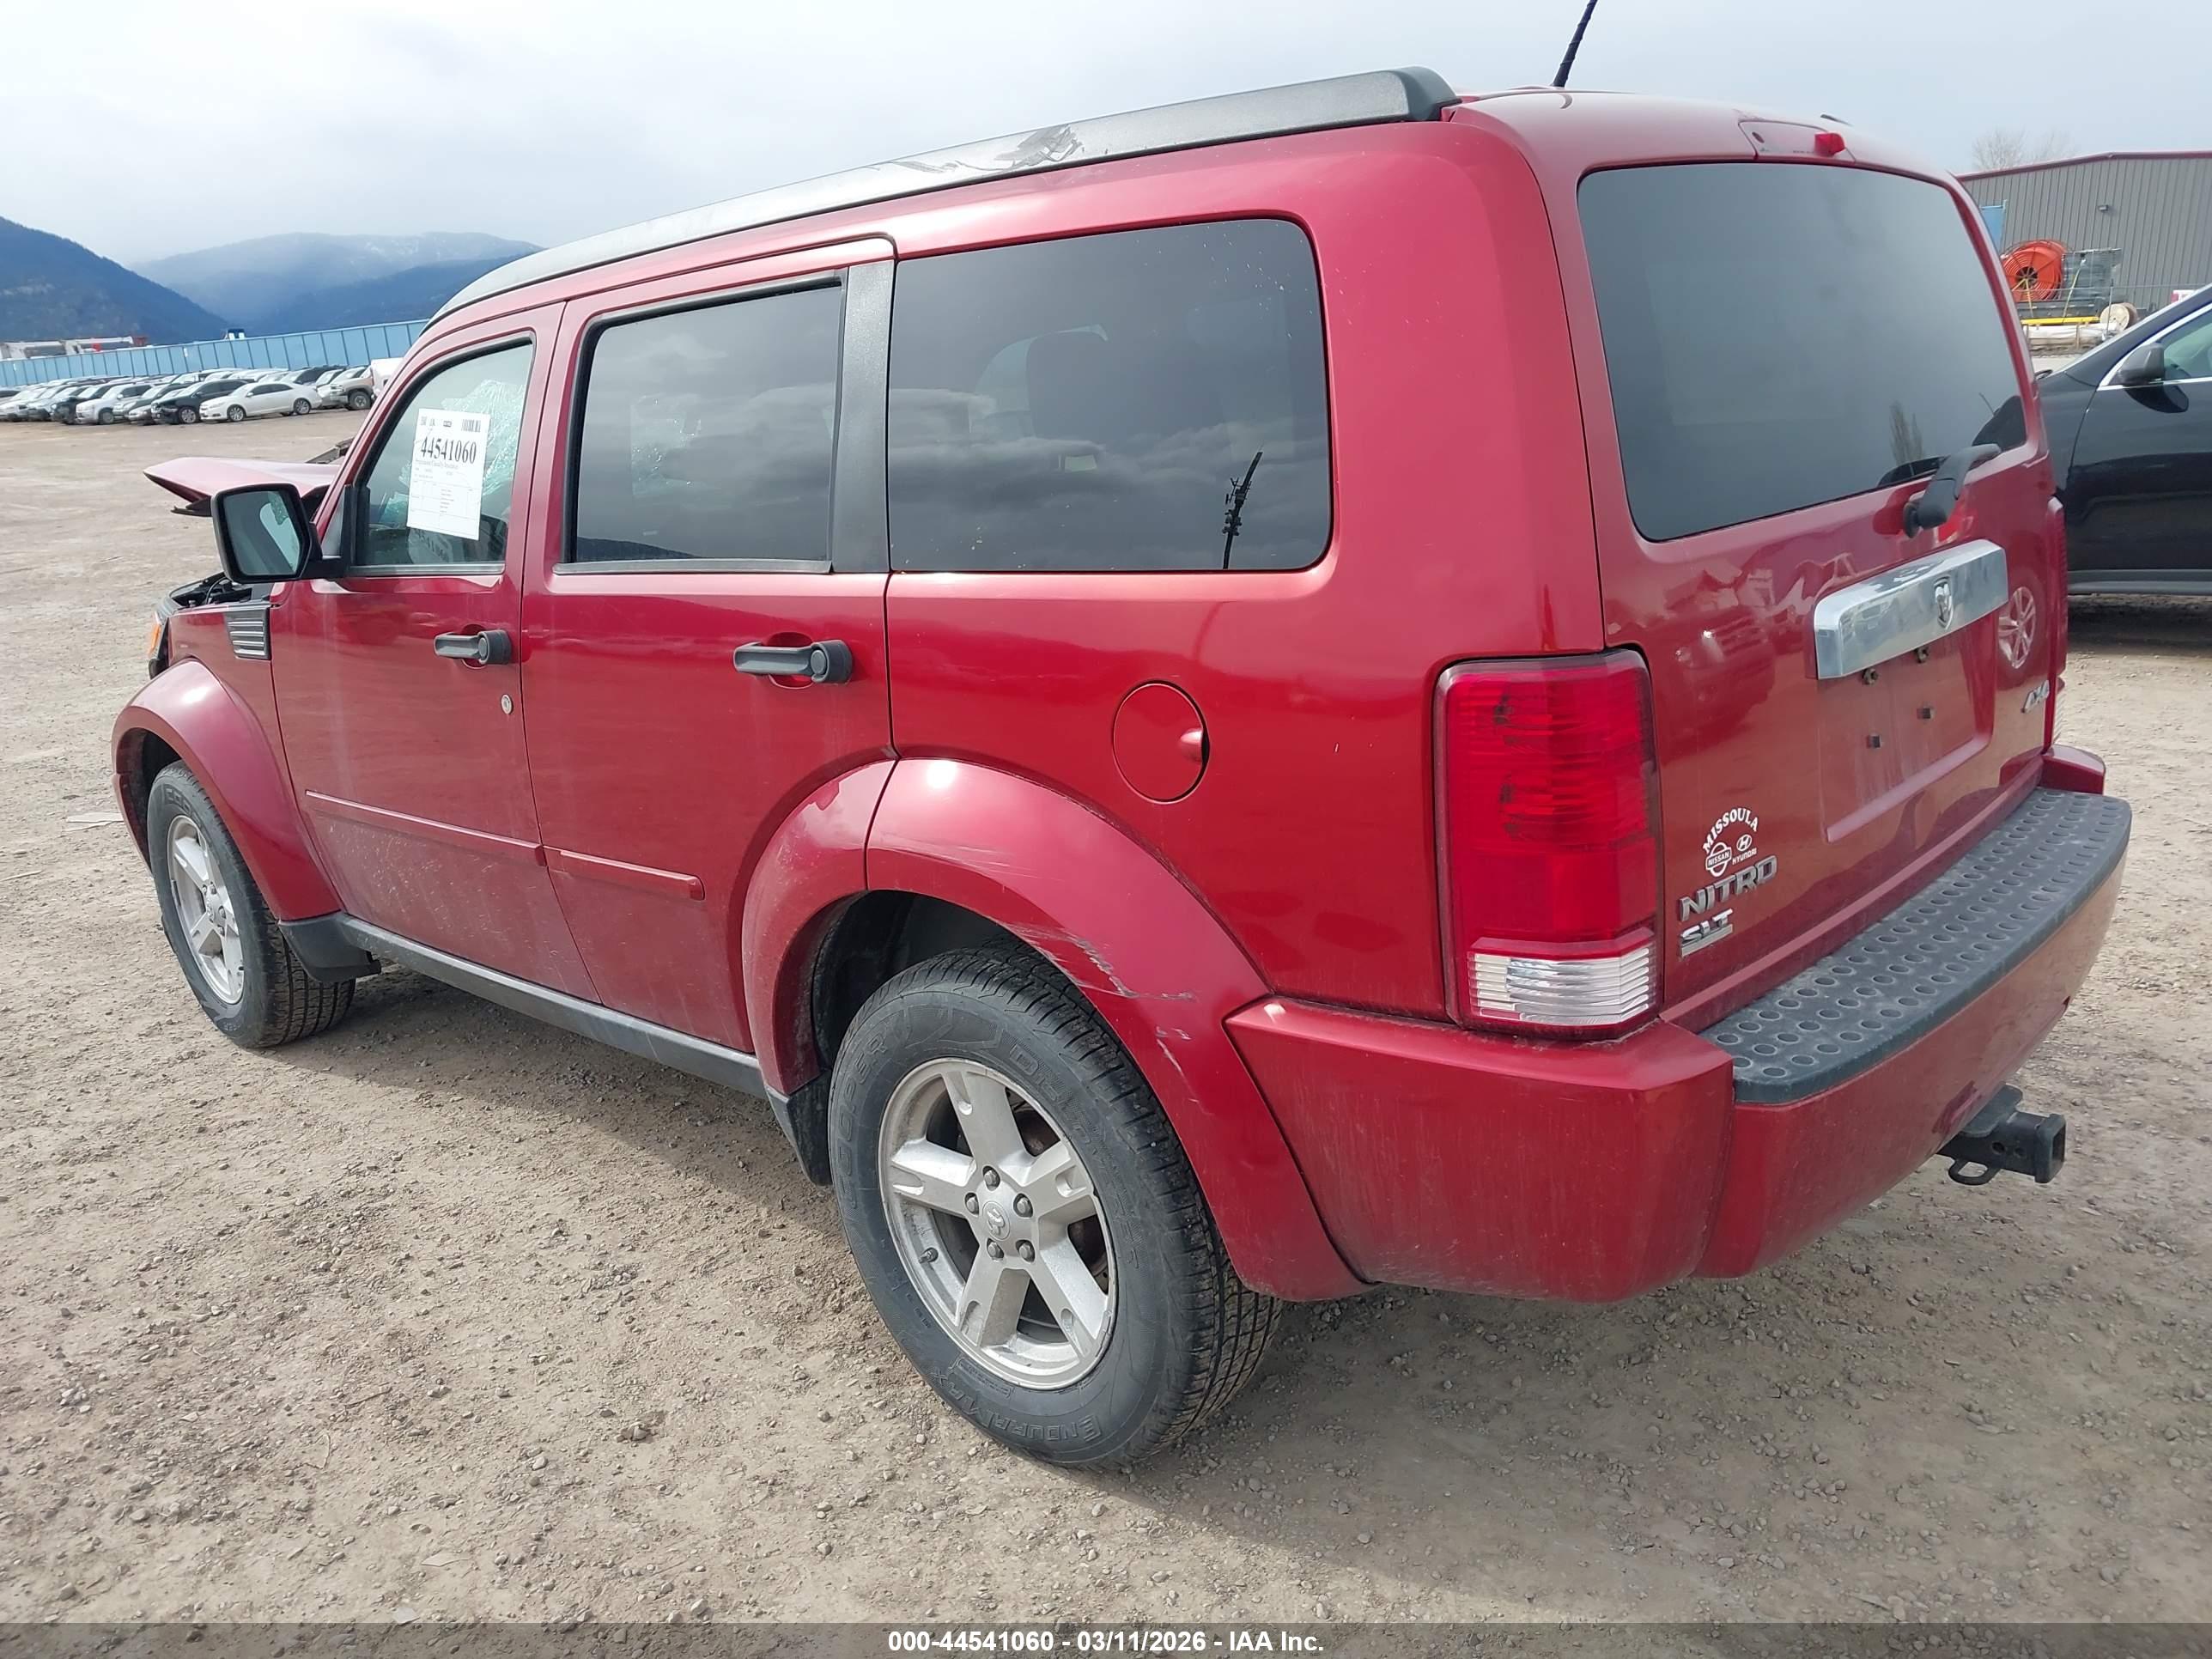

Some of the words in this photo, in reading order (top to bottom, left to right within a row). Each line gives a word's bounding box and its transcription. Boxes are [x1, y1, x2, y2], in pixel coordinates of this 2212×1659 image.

[421, 436, 477, 465] 44541060
[1703, 807, 1759, 854] MISSOULA
[1707, 851, 1730, 866] NISSAN
[1680, 855, 1778, 921] NITRO
[1680, 908, 1733, 944] SLT
